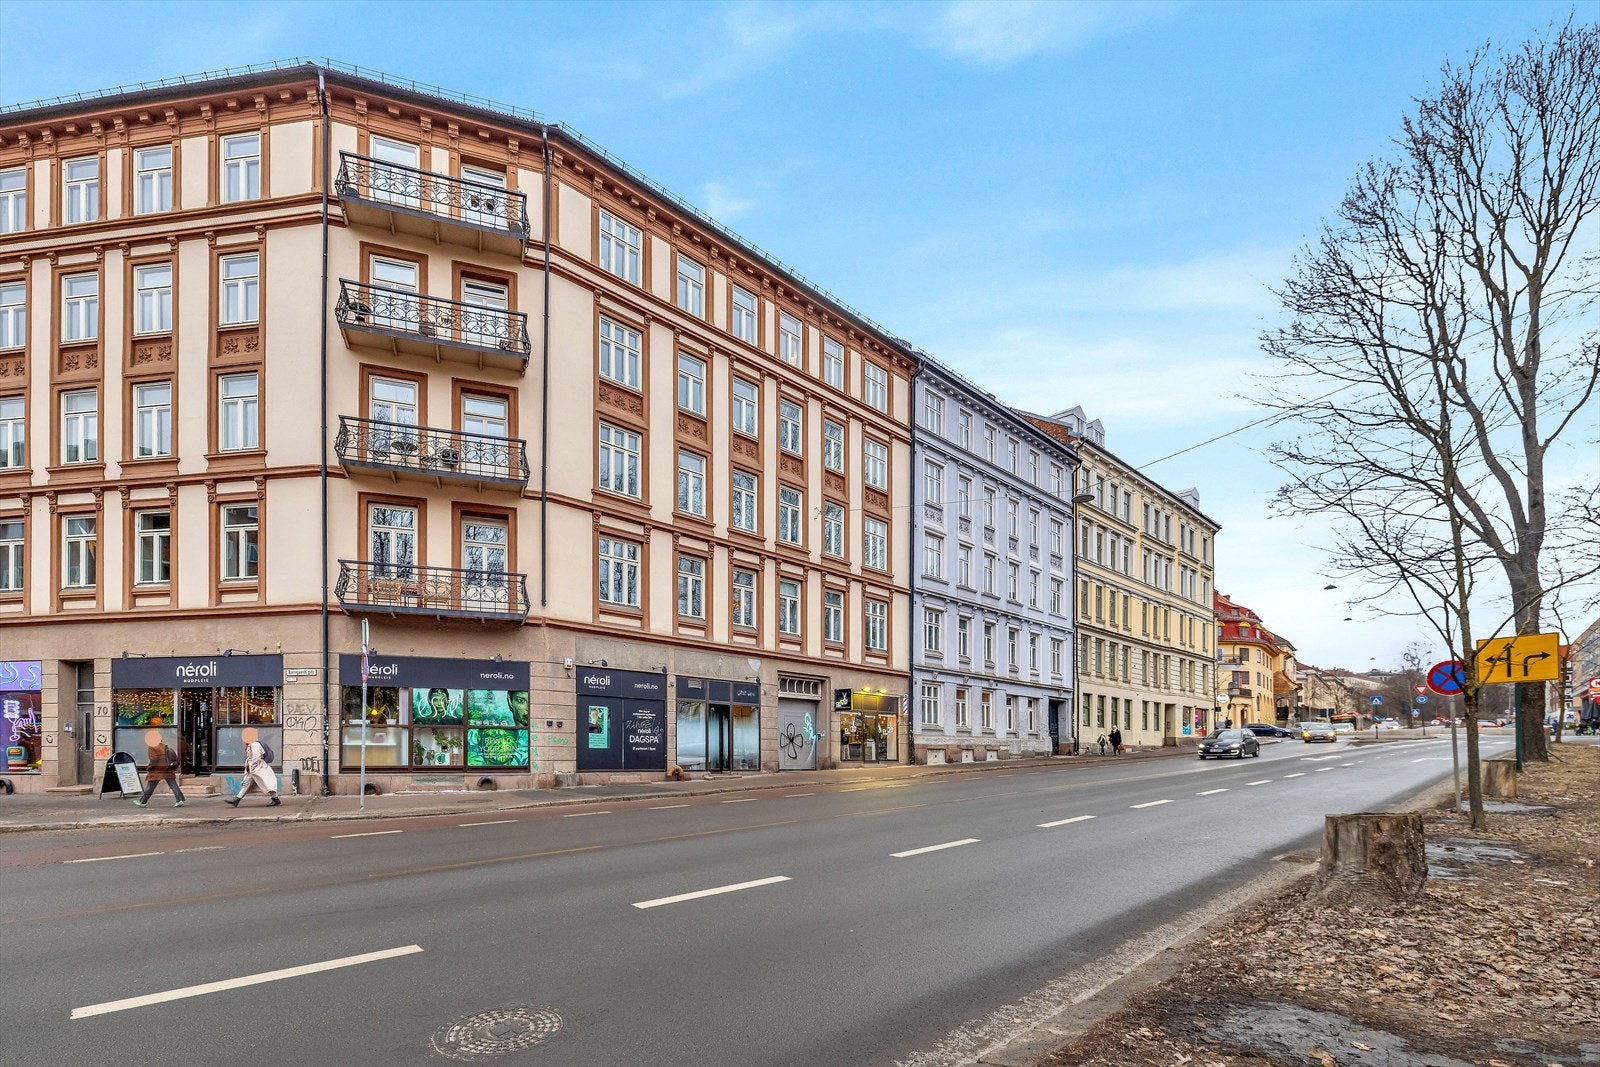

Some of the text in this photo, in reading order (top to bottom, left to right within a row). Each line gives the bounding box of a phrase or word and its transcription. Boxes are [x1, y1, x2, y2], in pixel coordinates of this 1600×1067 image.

[176, 661, 217, 677] néroli
[480, 672, 515, 680] neroli.no
[584, 674, 611, 686] néroli
[97, 706, 109, 716] 70
[418, 696, 460, 719] esse
[629, 735, 660, 743] DAGSPA
